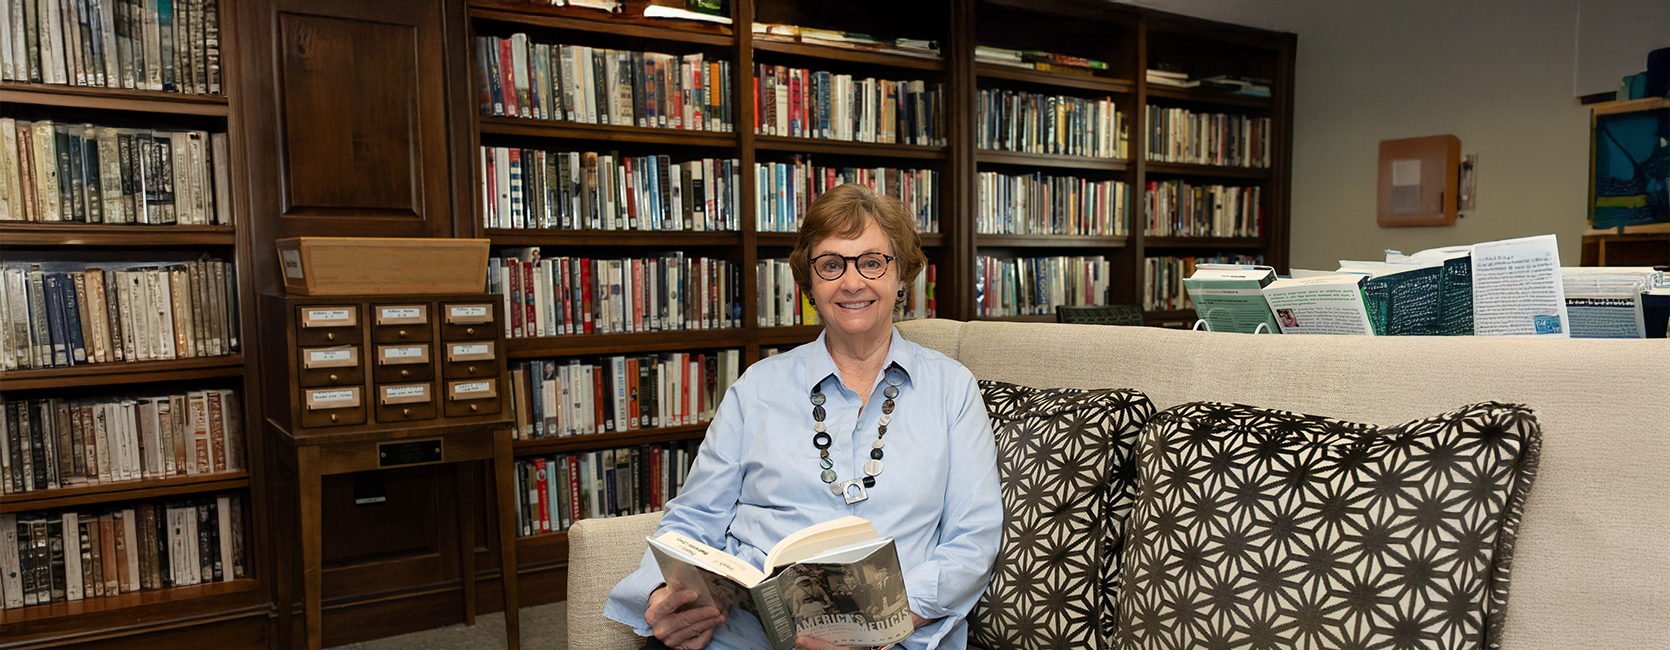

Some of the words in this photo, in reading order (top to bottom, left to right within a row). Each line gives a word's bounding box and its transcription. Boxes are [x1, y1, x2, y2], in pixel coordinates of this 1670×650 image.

[760, 586, 783, 618] AMERICA'S
[796, 614, 866, 633] AMERICA'S
[858, 607, 911, 632] MEDICIS
